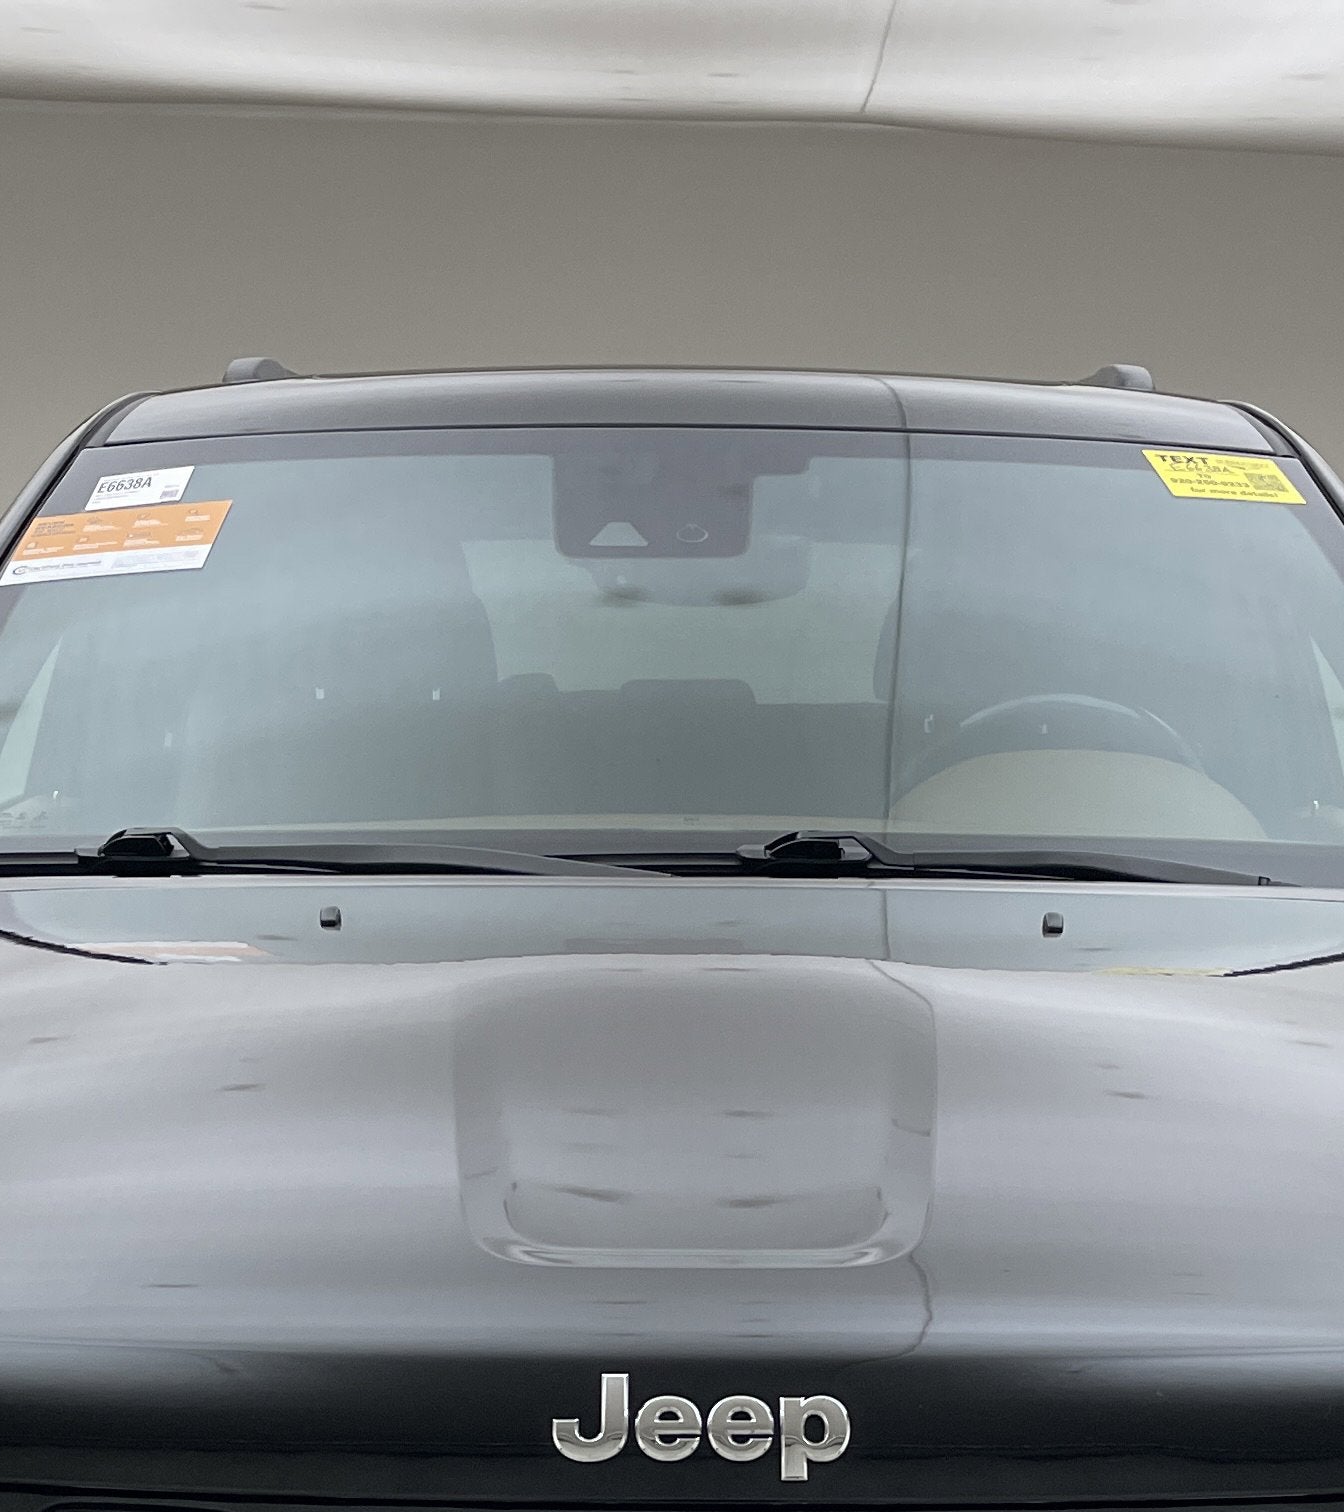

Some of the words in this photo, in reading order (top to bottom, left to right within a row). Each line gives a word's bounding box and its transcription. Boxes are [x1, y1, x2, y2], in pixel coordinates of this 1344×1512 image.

[1158, 454, 1208, 465] TEXT
[98, 476, 152, 494] E6638A
[552, 1373, 851, 1481] Jeep
